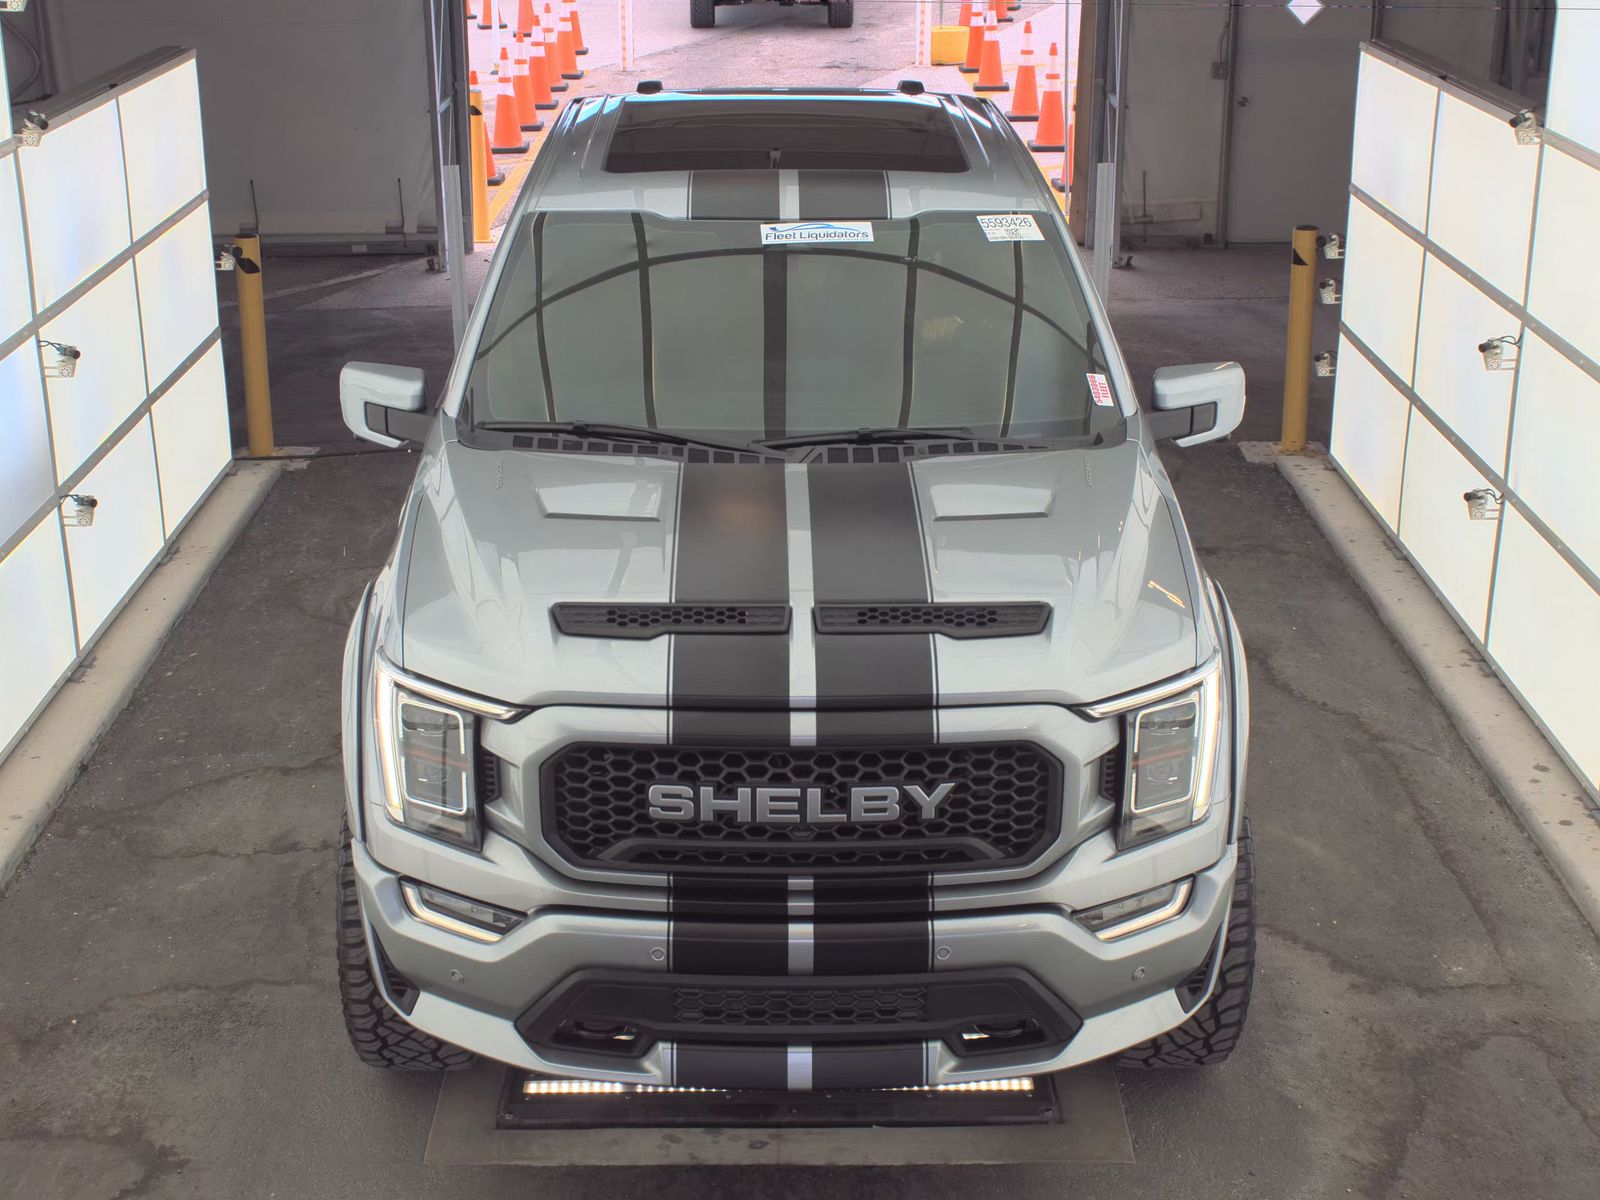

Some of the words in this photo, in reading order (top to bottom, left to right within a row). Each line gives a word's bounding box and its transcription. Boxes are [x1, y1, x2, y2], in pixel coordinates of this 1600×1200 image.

[980, 217, 1032, 228] 5593426
[765, 231, 796, 240] Fleet
[799, 230, 869, 240] Liquidators
[648, 782, 956, 823] SHELBY
